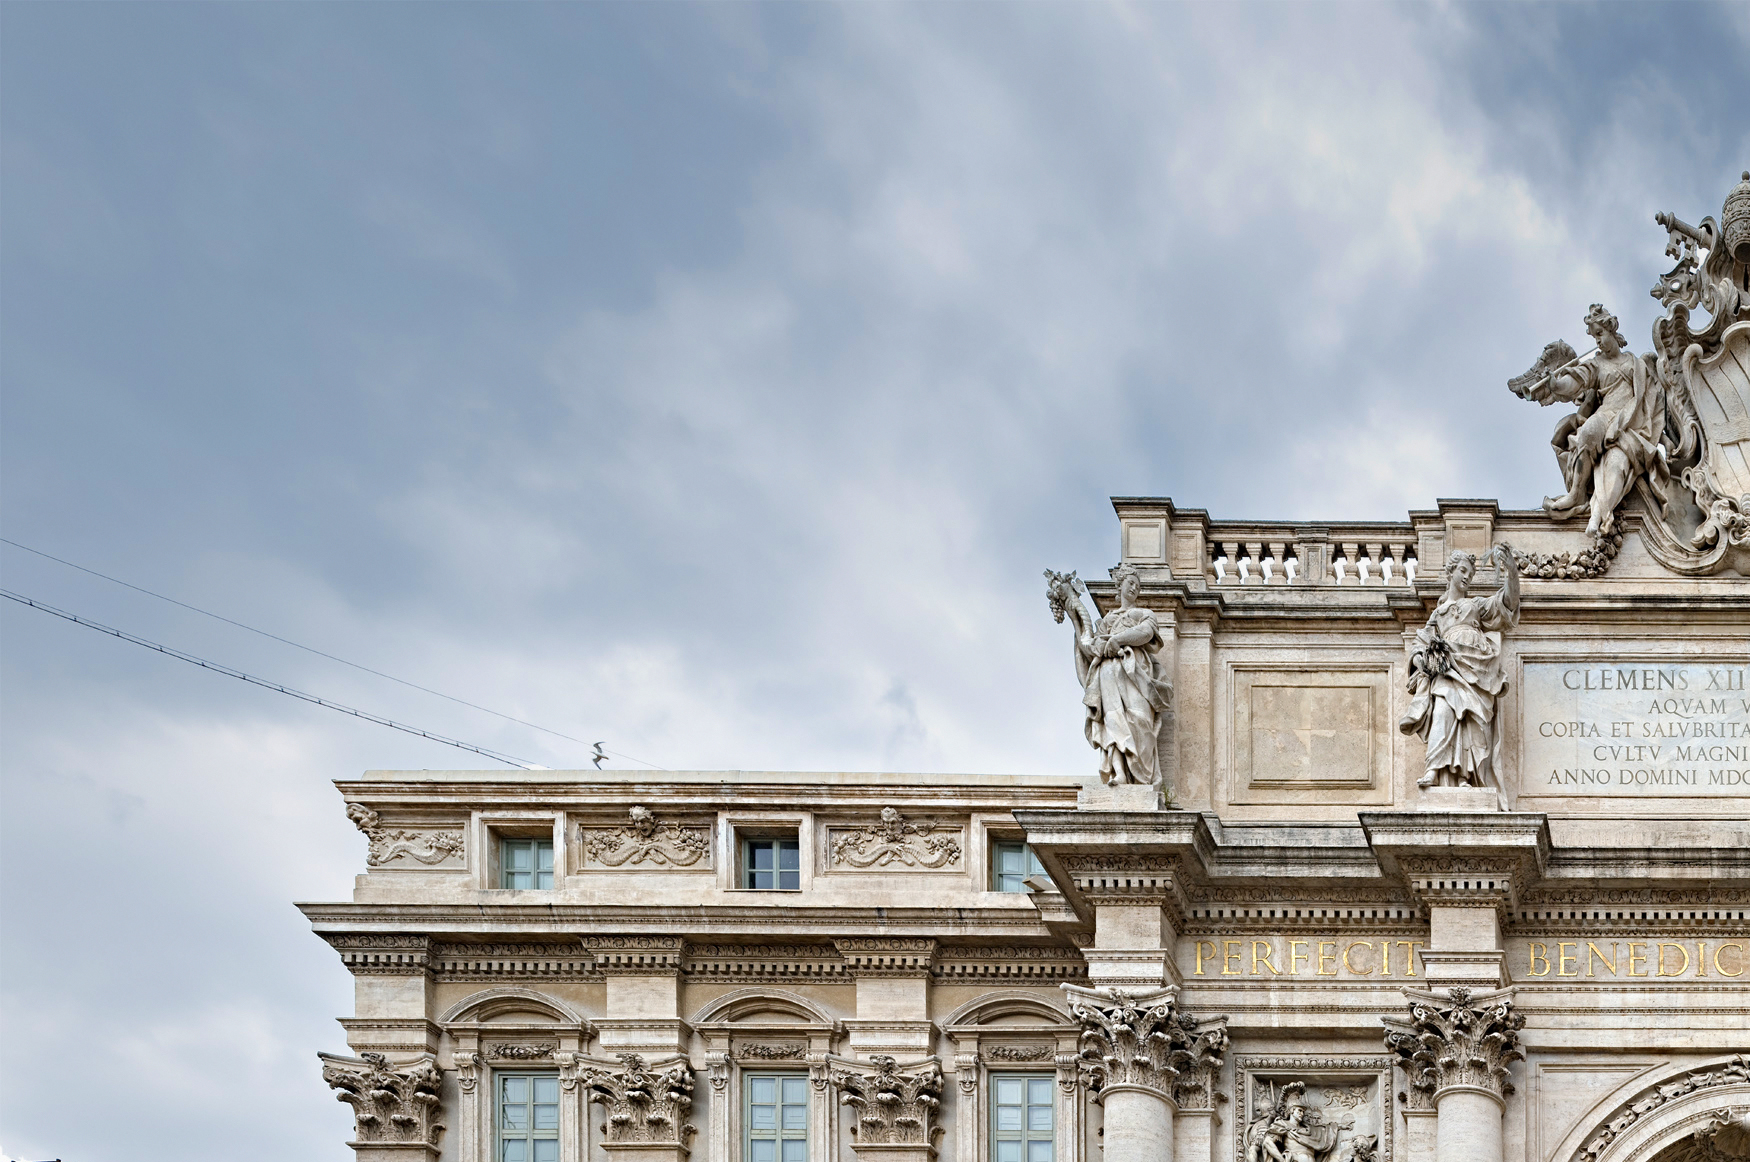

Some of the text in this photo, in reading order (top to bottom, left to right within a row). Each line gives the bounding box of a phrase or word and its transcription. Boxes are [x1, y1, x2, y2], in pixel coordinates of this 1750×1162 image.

[1562, 669, 1690, 691] CLEMENS
[1648, 698, 1727, 719] AQVAM
[1539, 721, 1602, 739] COPIA
[1611, 721, 1634, 738] ET
[1593, 745, 1661, 762] CVLTV
[1547, 769, 1611, 786] ANNO
[1619, 769, 1697, 786] DOMINI
[1193, 940, 1426, 977] PERFECIT
